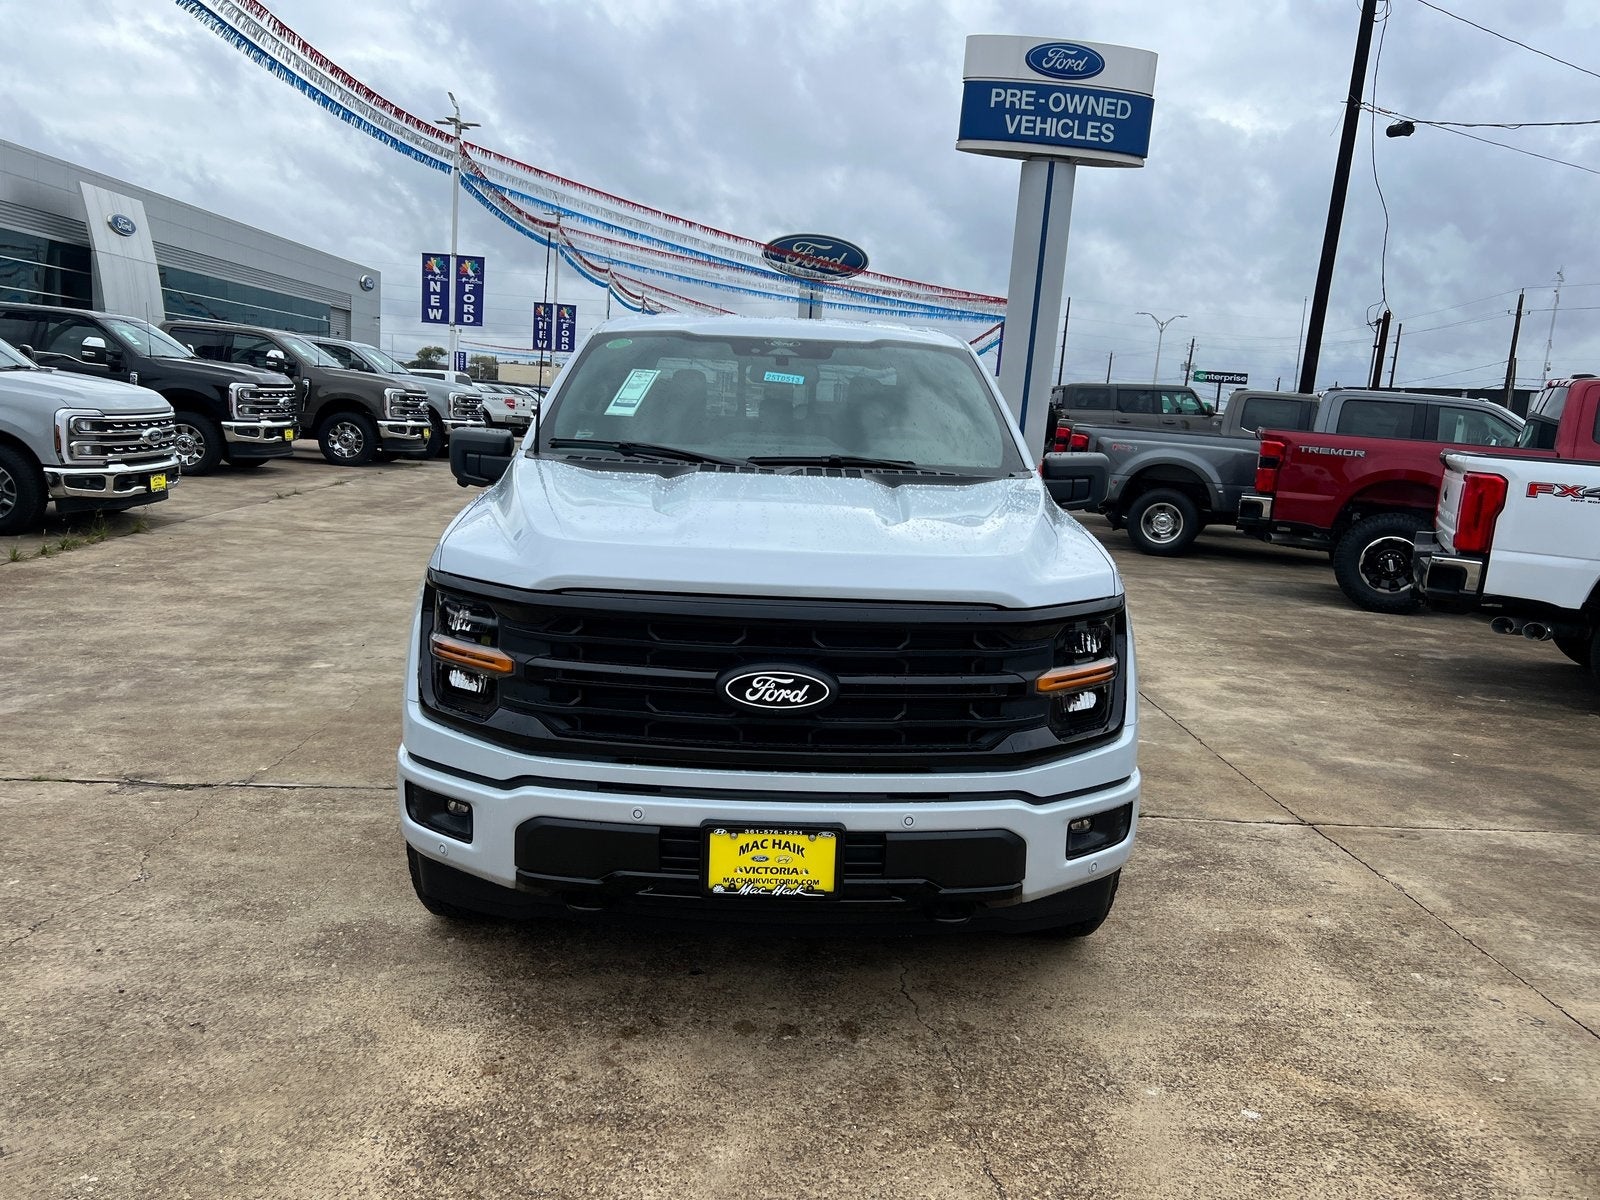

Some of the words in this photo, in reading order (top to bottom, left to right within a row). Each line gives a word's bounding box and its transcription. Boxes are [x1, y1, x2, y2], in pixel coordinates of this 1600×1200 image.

[1042, 47, 1089, 72] Ford
[990, 88, 1132, 120] PRE-OWNED
[1005, 114, 1115, 143] VEHICLES
[428, 280, 442, 320] NEW
[463, 283, 475, 323] FORD
[537, 321, 548, 349] NEW
[561, 323, 570, 350] FORD
[1195, 373, 1247, 382] enterprise
[1298, 445, 1366, 458] TREMOR
[745, 676, 810, 703] Ford
[739, 838, 769, 857] MAC
[772, 838, 806, 858] HAIK
[722, 877, 820, 886] MACHAIKVICTORIA.COM
[743, 866, 800, 876] VICTORIA
[738, 882, 769, 896] Mac
[771, 883, 812, 896] Haik
